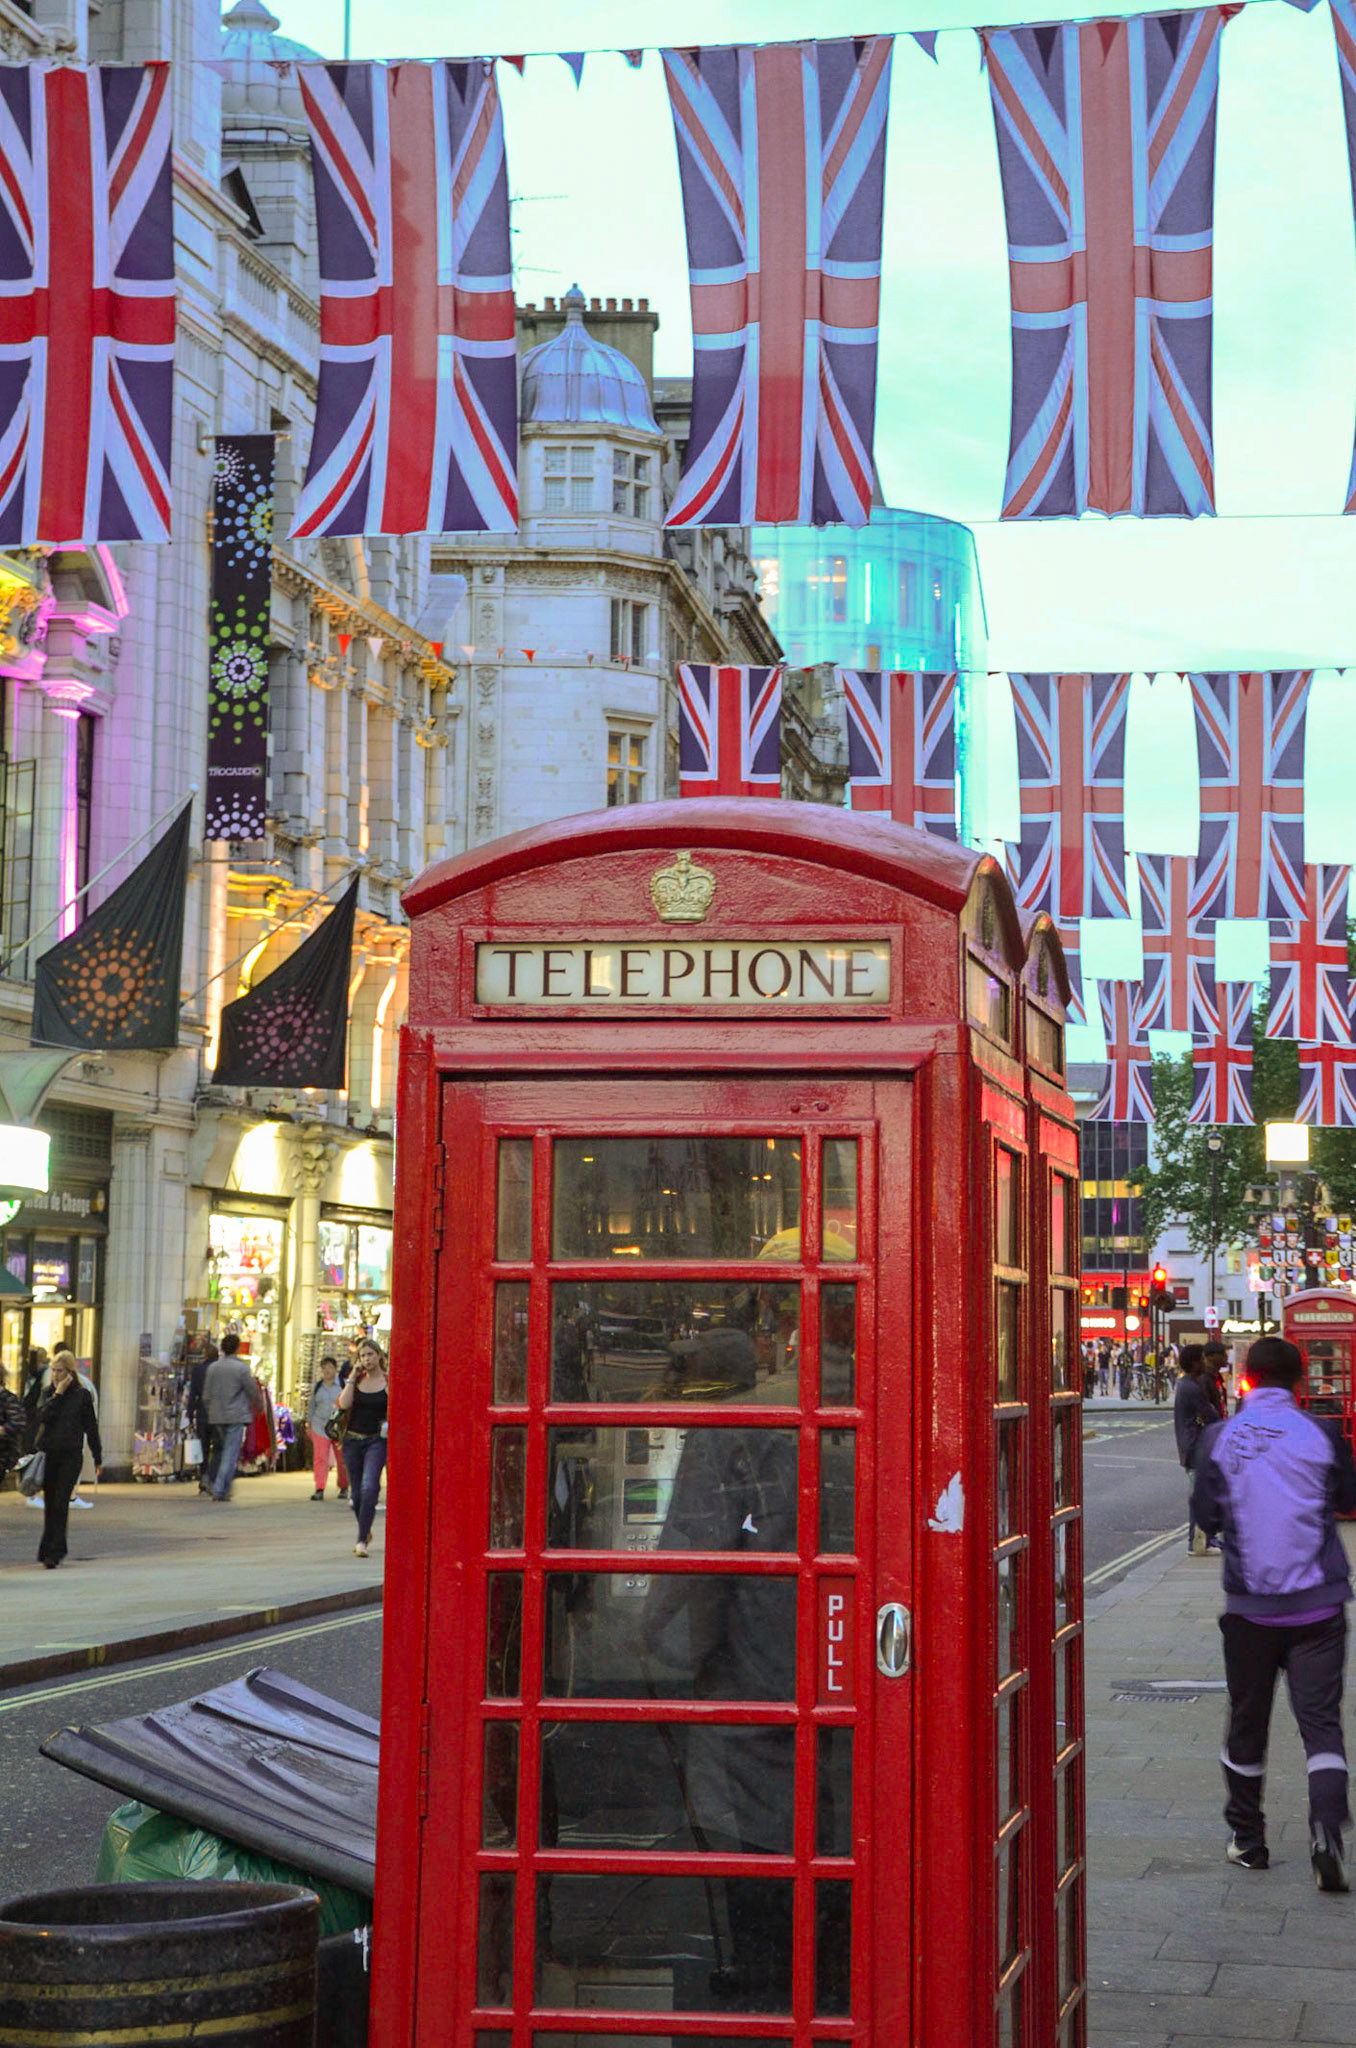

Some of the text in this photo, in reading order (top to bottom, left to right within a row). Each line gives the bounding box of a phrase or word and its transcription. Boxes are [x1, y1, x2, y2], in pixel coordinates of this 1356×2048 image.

[208, 767, 261, 776] TROCADERO
[492, 948, 876, 999] TELEPHONE
[62, 1192, 90, 1218] Change
[828, 1595, 843, 1691] PULL
